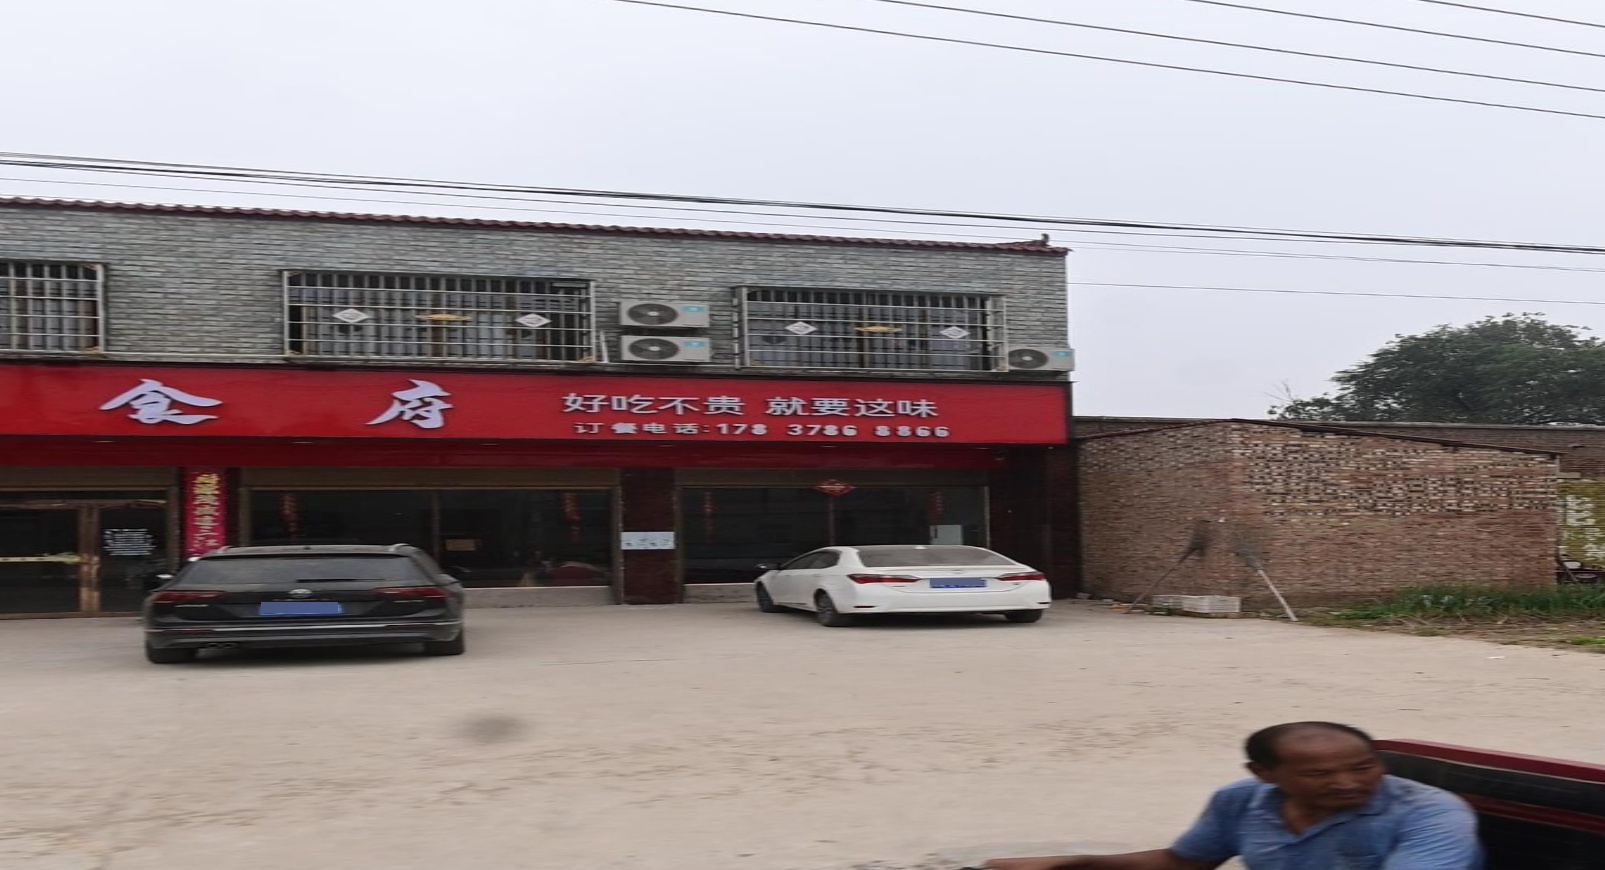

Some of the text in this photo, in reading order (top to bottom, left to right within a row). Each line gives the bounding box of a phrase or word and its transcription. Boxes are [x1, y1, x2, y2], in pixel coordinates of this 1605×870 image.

[562, 392, 939, 418] 好吃不贵 就要这味
[787, 423, 857, 437] 3786
